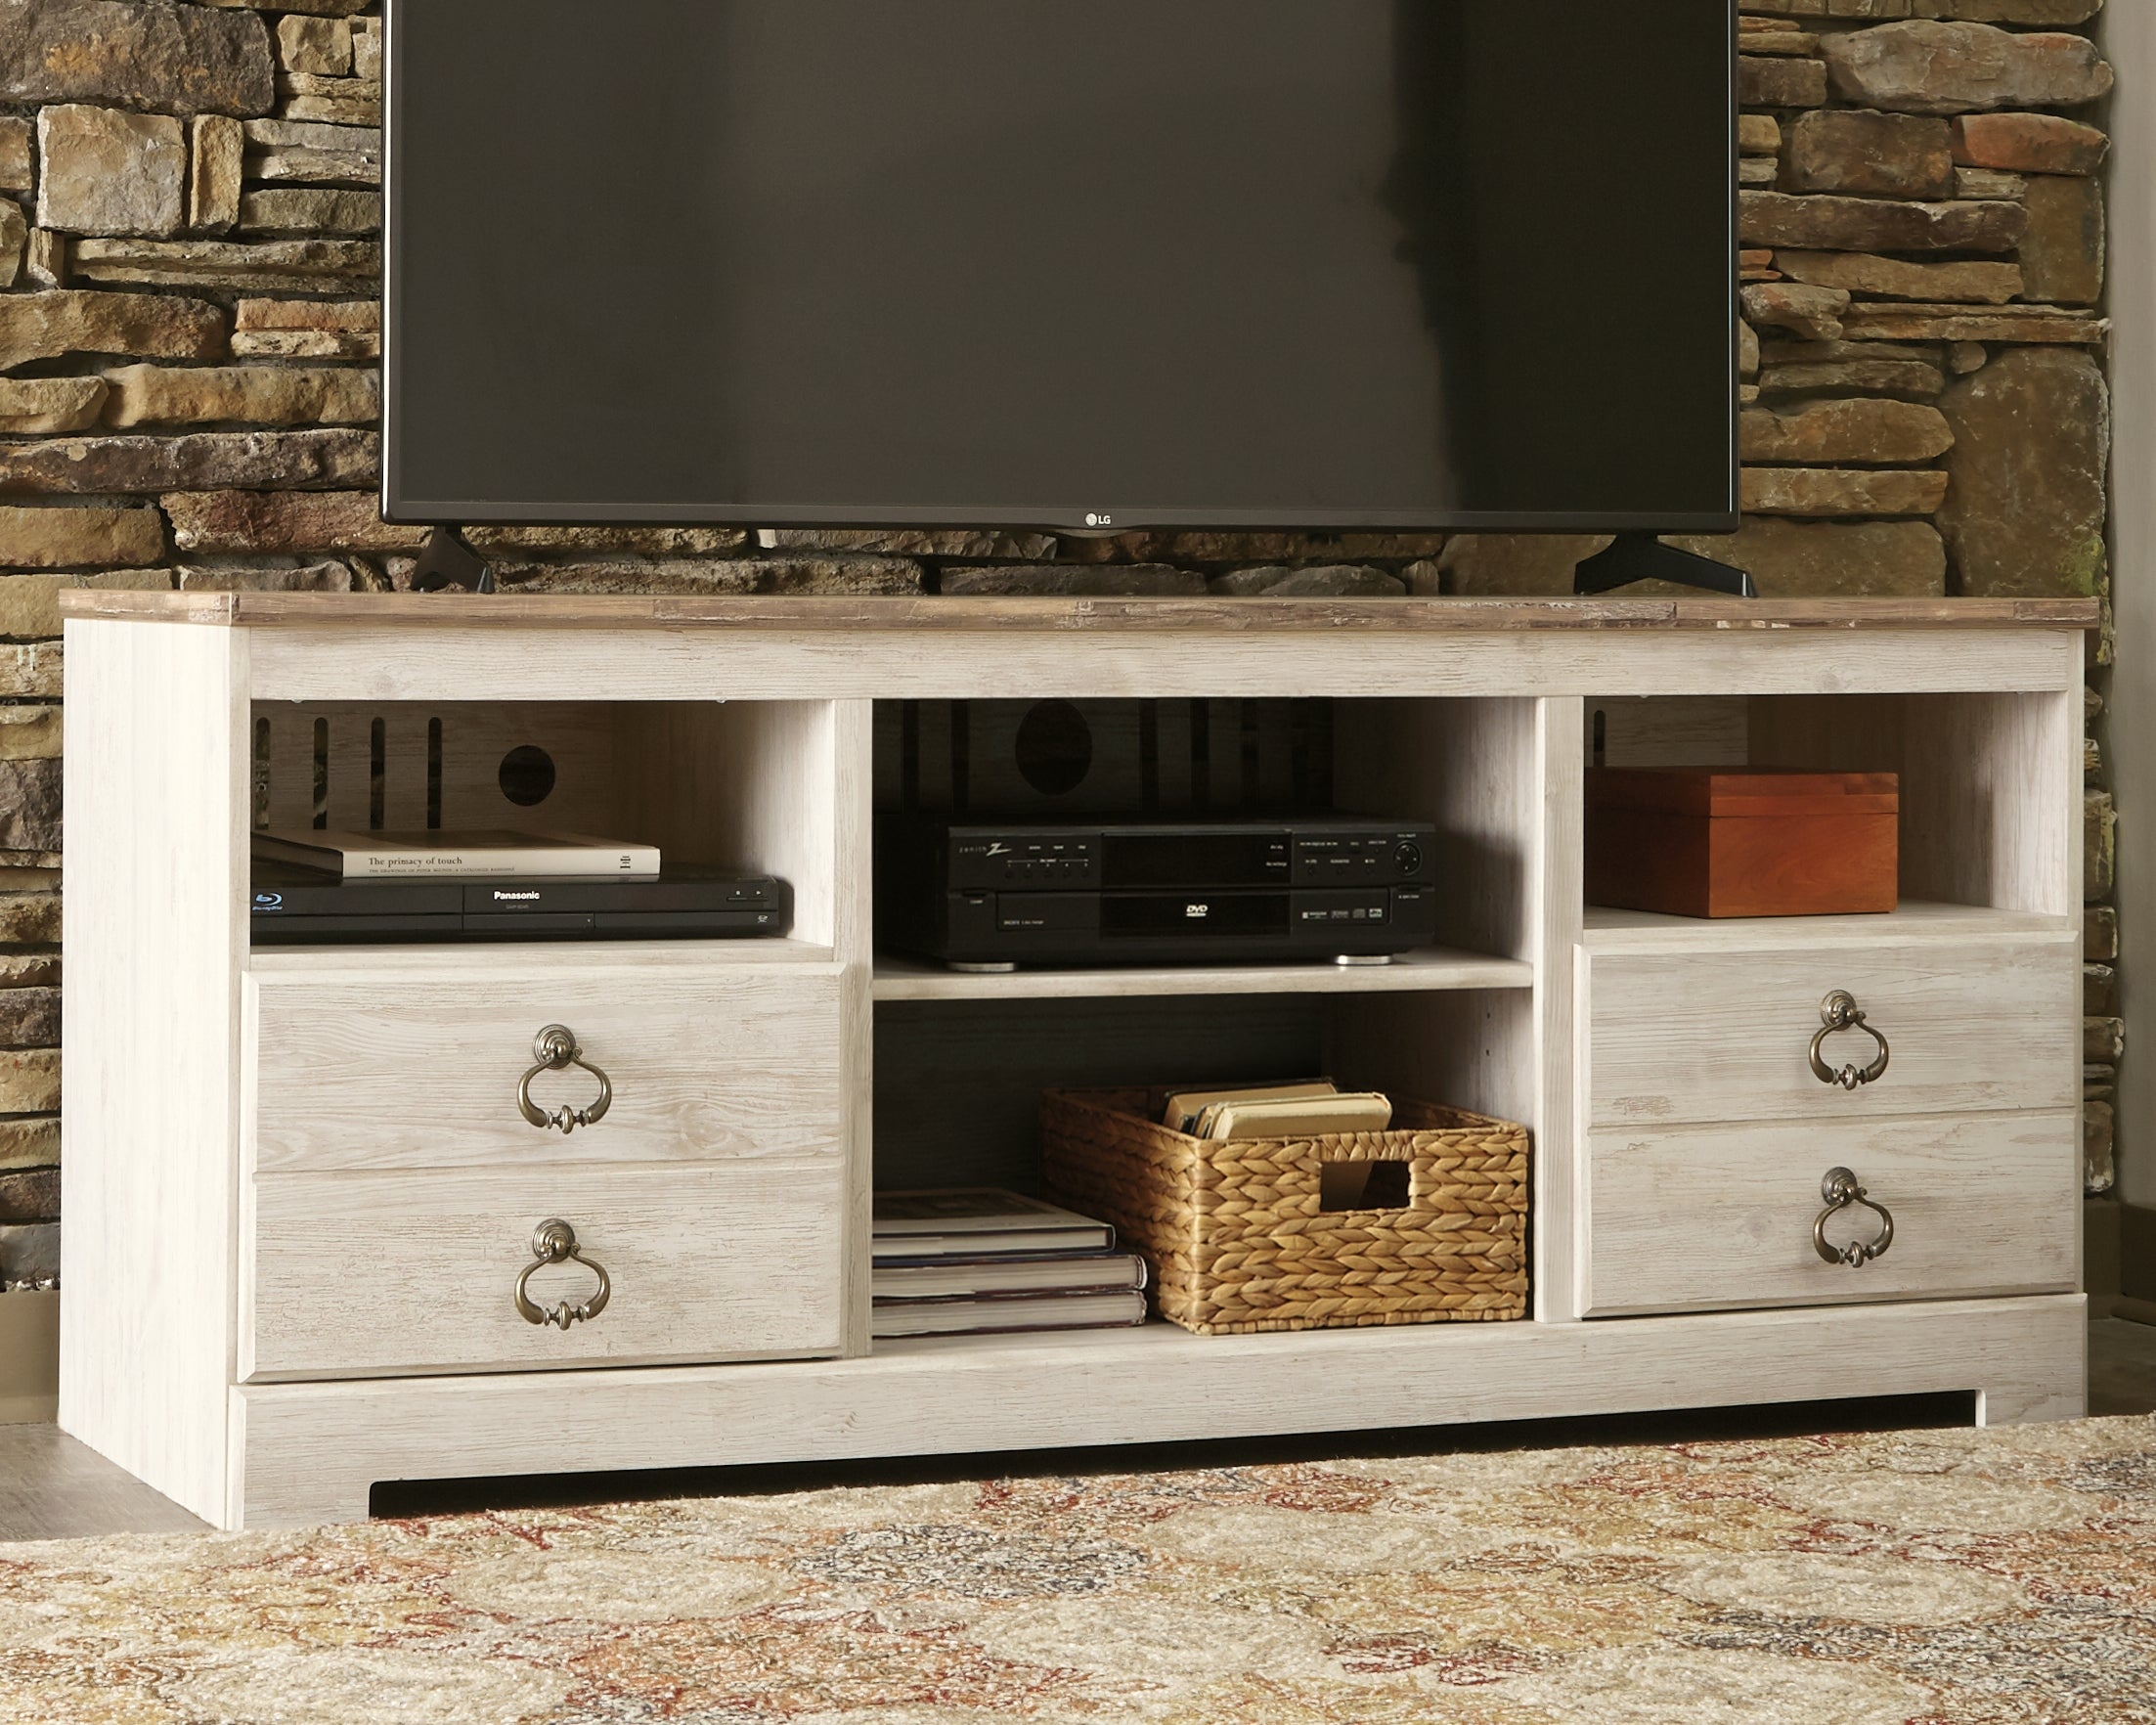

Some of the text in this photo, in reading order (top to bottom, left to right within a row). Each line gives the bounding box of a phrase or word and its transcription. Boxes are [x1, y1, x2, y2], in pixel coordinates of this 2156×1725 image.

[1098, 515, 1111, 525] LG
[369, 857, 385, 865] The
[388, 858, 422, 867] primacy
[494, 891, 540, 900] Panasonic
[1186, 905, 1209, 913] DVD
